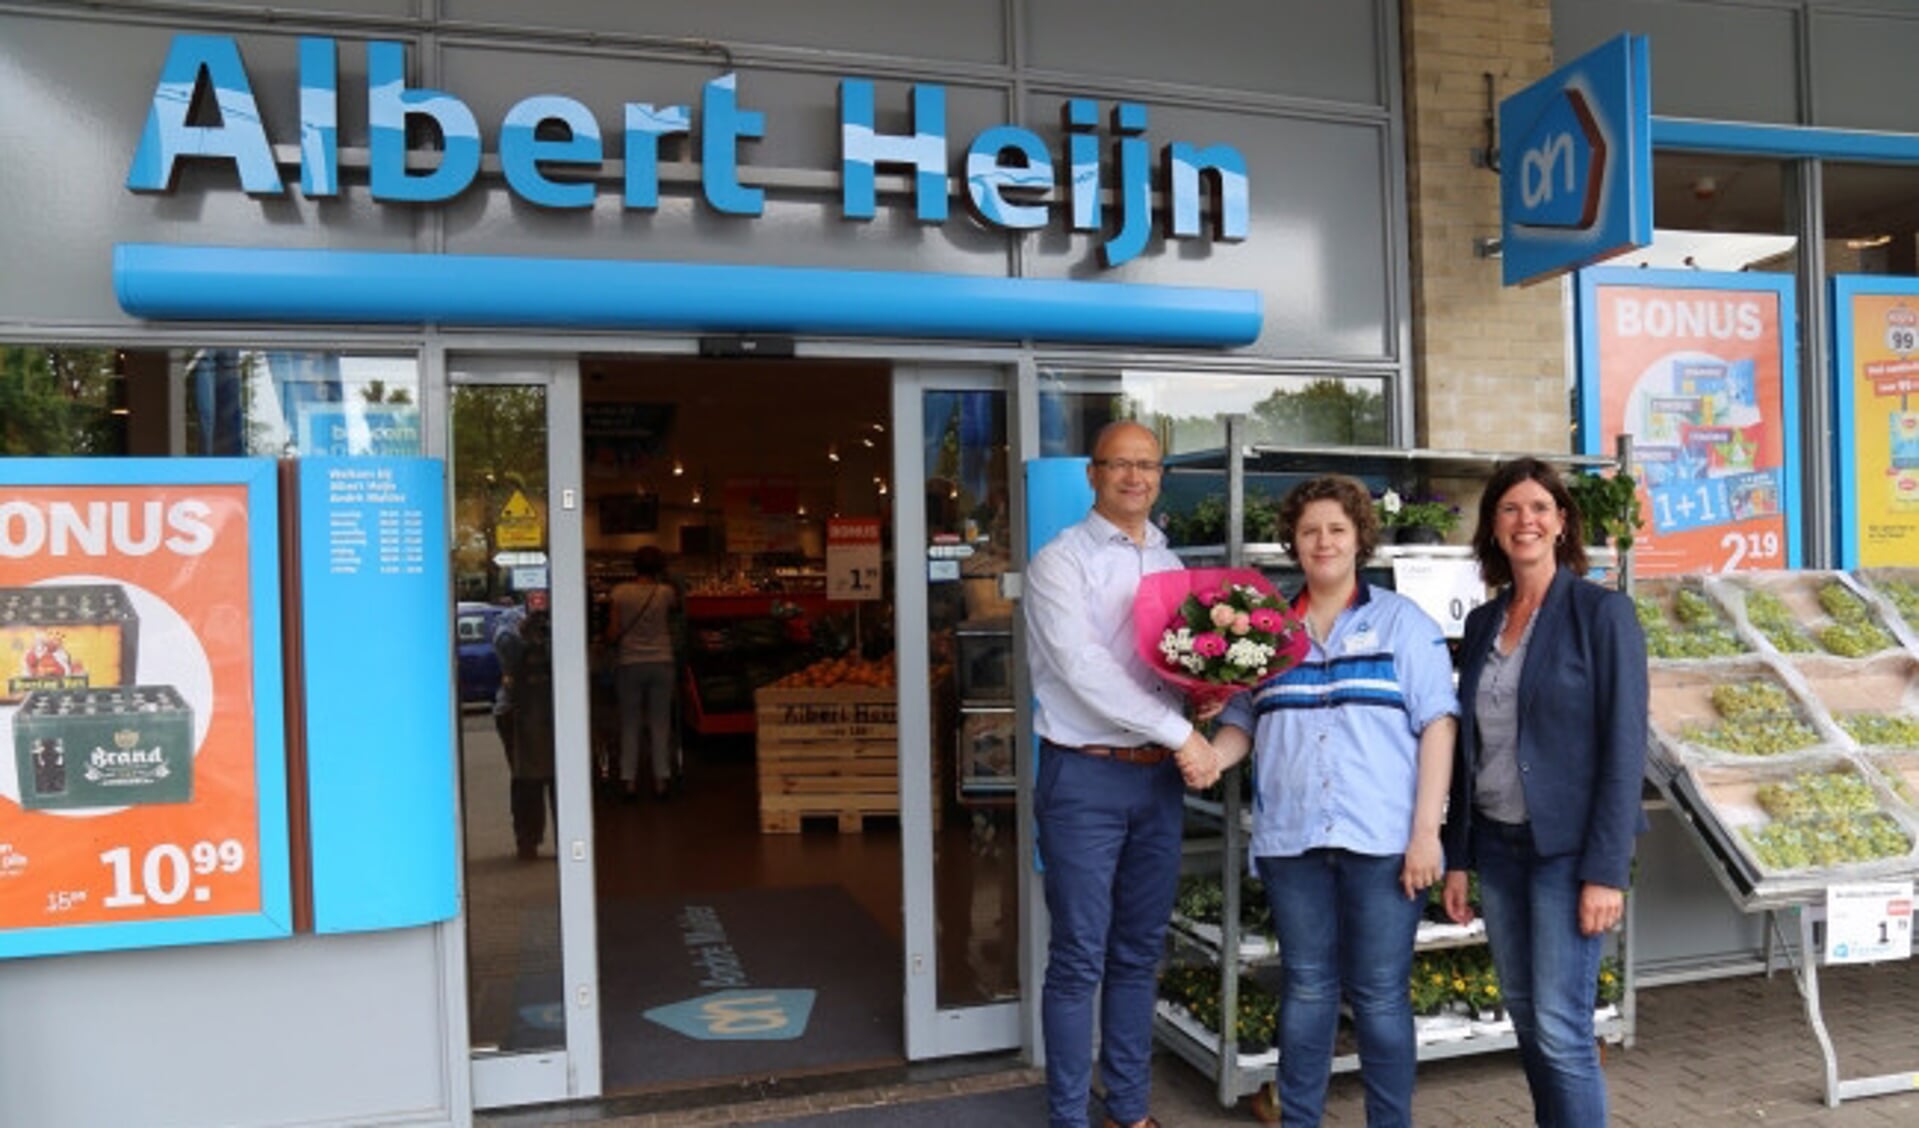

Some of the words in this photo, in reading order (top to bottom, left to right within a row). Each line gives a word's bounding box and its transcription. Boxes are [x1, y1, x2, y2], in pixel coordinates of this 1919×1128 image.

[126, 34, 766, 218] Albert
[838, 77, 1251, 268] Heijn
[1616, 299, 1764, 342] BONUS
[1891, 331, 1914, 349] 99
[1656, 484, 1716, 527] 1+1
[828, 524, 878, 538] BONUS
[91, 745, 163, 769] Brand
[99, 839, 244, 908] 10.99
